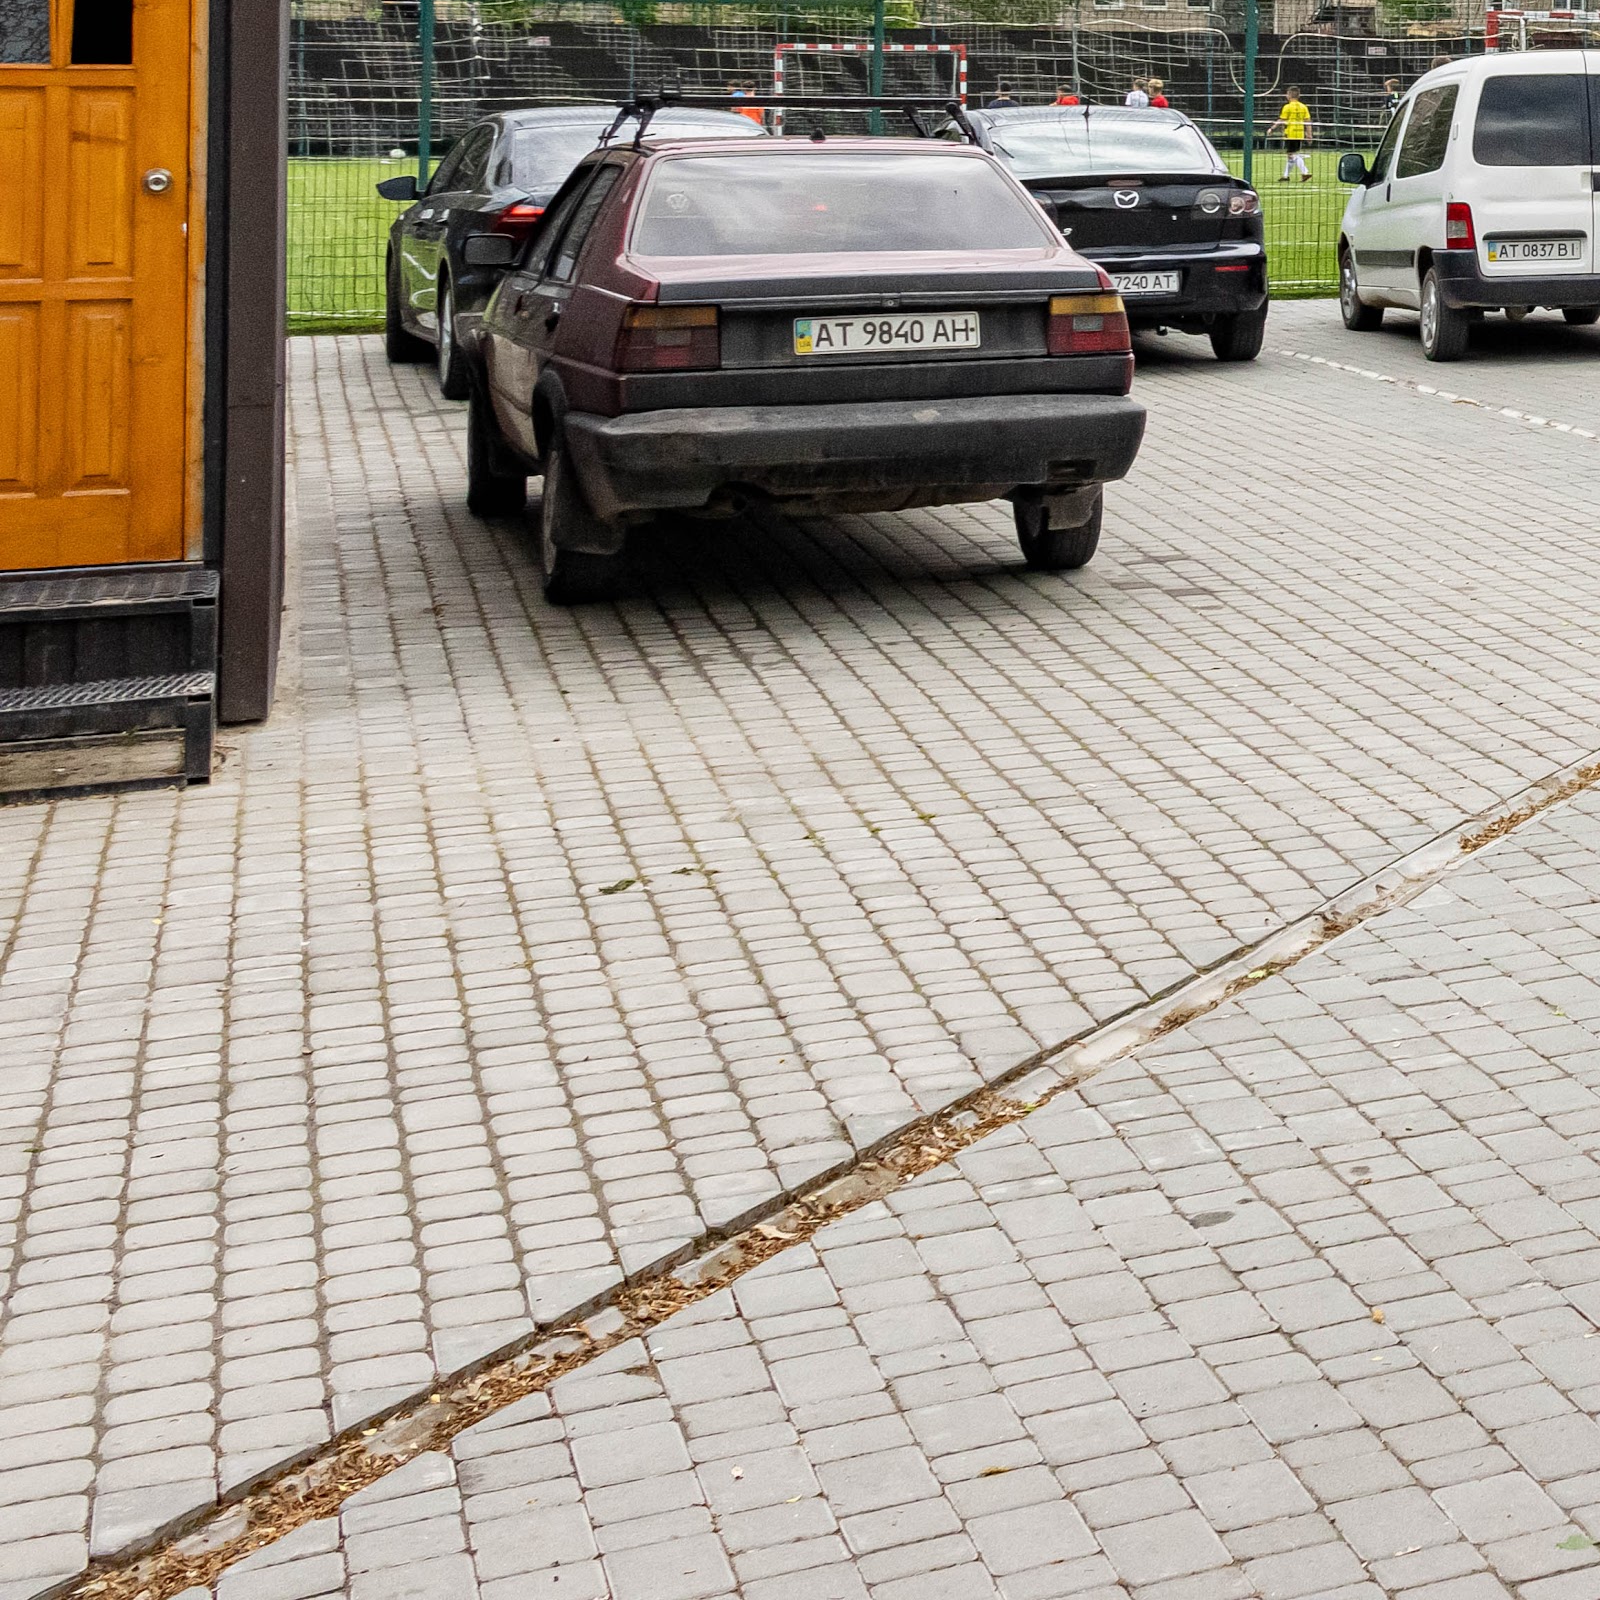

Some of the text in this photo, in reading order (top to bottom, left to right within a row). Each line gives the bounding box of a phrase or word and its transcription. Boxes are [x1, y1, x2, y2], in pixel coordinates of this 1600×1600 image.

[1499, 243, 1575, 258] AT 0837 BI
[1114, 274, 1173, 290] 7240 AT
[815, 319, 970, 348] AT 9840 AH
